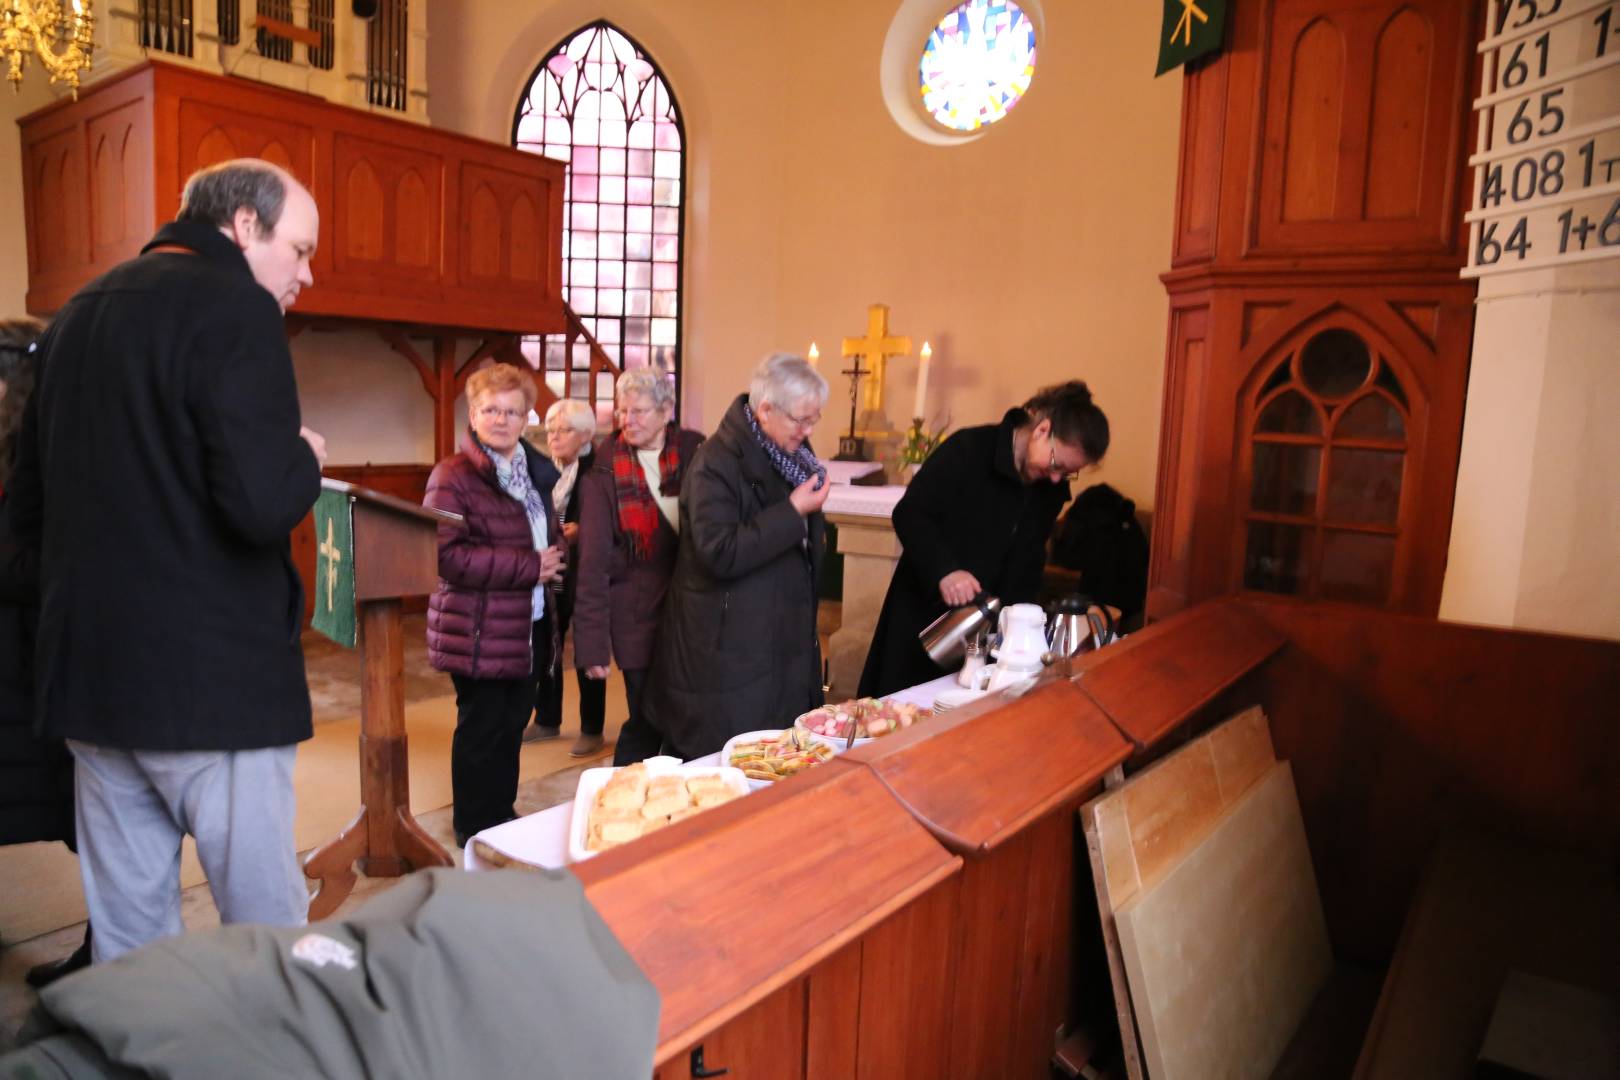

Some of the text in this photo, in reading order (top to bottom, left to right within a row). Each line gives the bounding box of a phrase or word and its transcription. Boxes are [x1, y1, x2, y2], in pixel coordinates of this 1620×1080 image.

[1502, 31, 1550, 89] 61
[1507, 88, 1564, 144] 65
[1480, 149, 1565, 207] 408
[1477, 215, 1532, 266] 64
